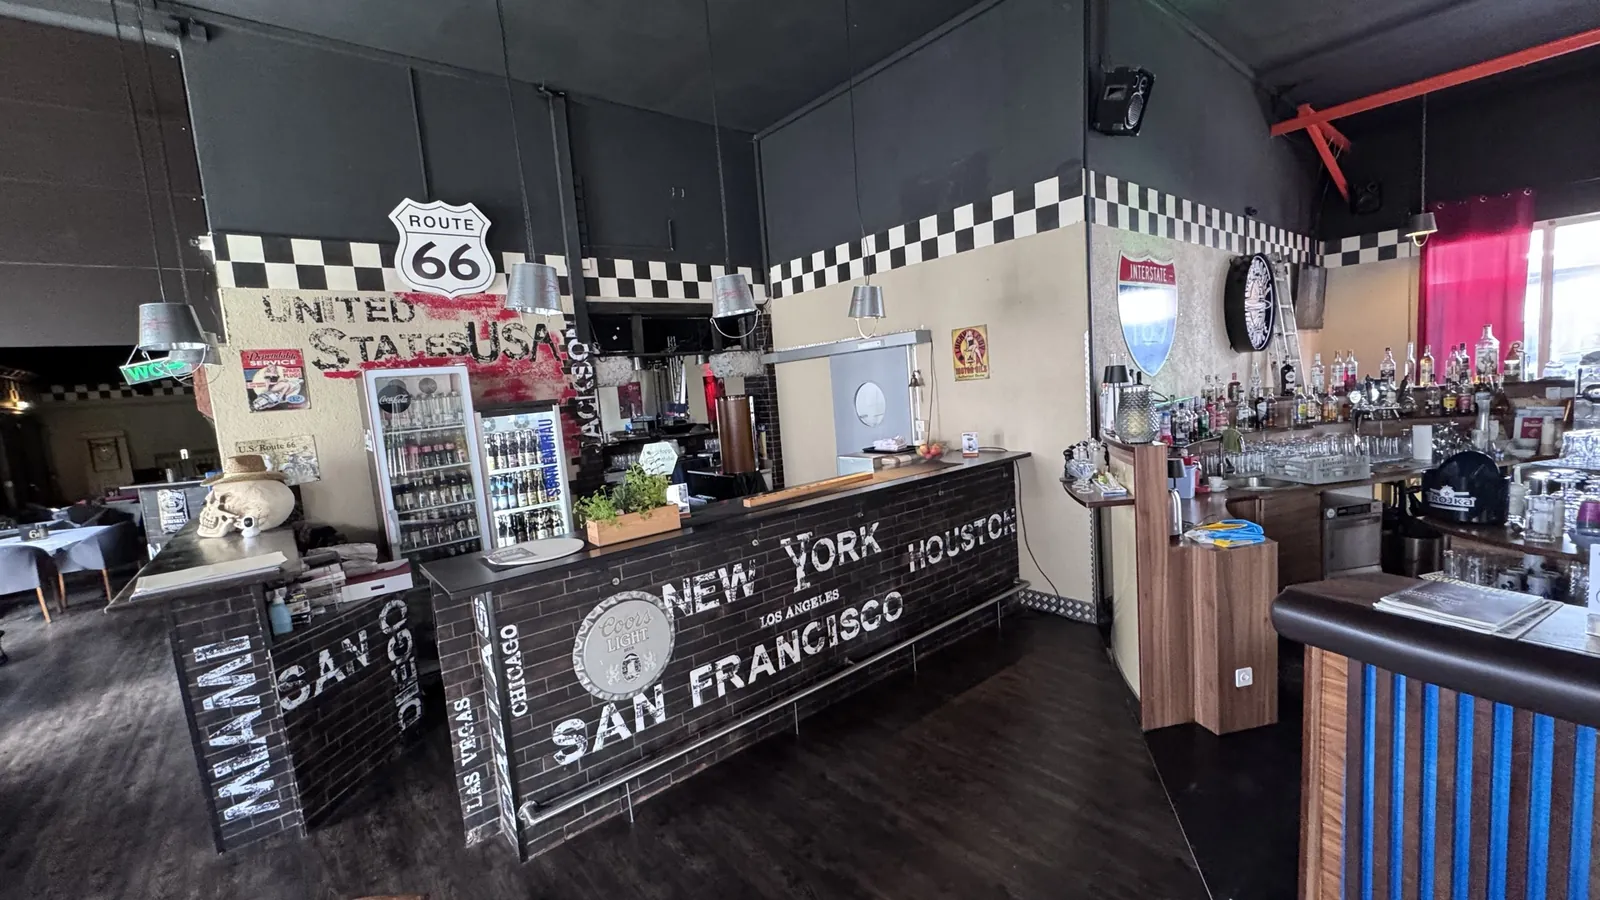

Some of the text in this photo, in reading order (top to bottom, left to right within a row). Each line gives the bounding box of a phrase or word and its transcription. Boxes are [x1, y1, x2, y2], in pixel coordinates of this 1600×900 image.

[409, 215, 474, 231] ROUTE
[412, 241, 480, 281] 66
[1129, 263, 1167, 282] INTERSTATE
[262, 295, 415, 323] UNITED
[247, 351, 297, 361] Dependable
[309, 327, 469, 371] STATES
[465, 321, 562, 363] USA
[127, 362, 164, 381] WC
[250, 359, 296, 367] SERVICE
[259, 442, 284, 452] Route
[662, 508, 1016, 618] NEW YORK HOUSTON
[599, 609, 652, 637] Coors
[760, 588, 840, 628] LOS ANGELES
[606, 627, 649, 653] LIGHT
[277, 630, 371, 710] SAN
[379, 599, 422, 734] DIEGO
[500, 624, 528, 717] CHICAGO
[552, 591, 903, 765] SAN FRANCISCO
[193, 635, 280, 820] MIAMI
[454, 697, 482, 812] LAS VEGAS
